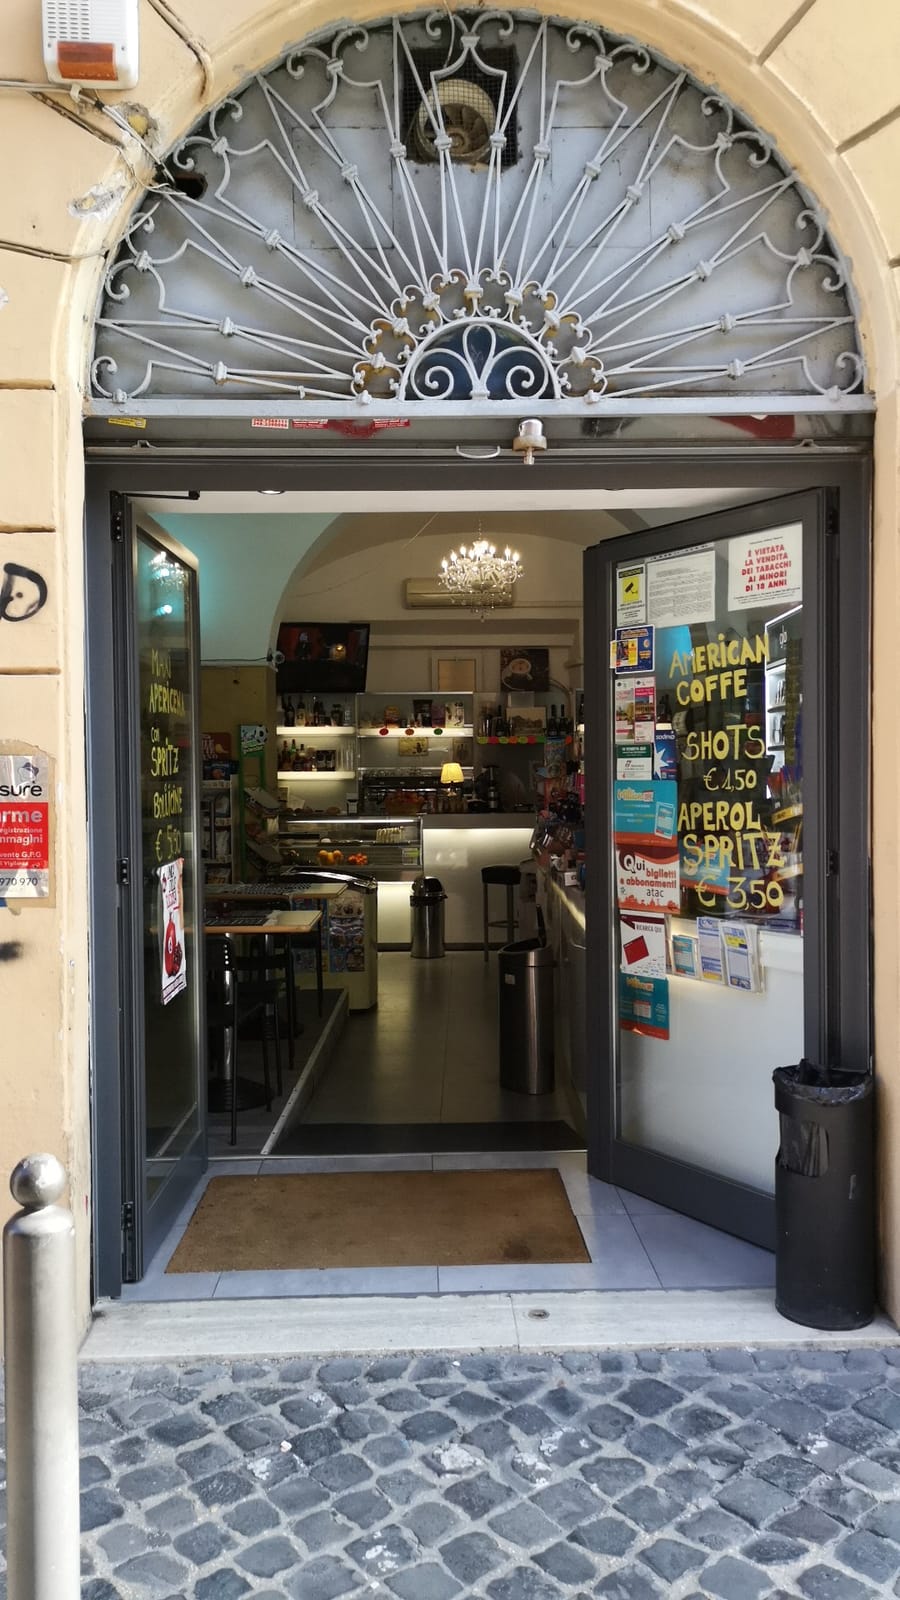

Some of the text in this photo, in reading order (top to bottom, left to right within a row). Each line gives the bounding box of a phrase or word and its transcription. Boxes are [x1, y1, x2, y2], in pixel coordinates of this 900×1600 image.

[754, 544, 785, 556] VIETATA
[744, 552, 788, 567] LA VENDITA
[741, 560, 792, 576] DEI TABACCHI
[748, 570, 787, 583] AI MINORI
[756, 582, 765, 590] 18
[767, 579, 788, 588] ANNI
[676, 668, 748, 706] COFFE
[681, 724, 766, 761] SHOTS
[703, 767, 758, 793] € 1,50
[0, 810, 43, 823] rme
[677, 801, 762, 832] APEROL
[622, 853, 645, 874] Qui
[646, 868, 677, 880] biglietti
[19, 877, 38, 887] 970
[626, 877, 677, 889] abbonamenti
[646, 888, 664, 898] atac
[694, 874, 785, 911] € 3,50
